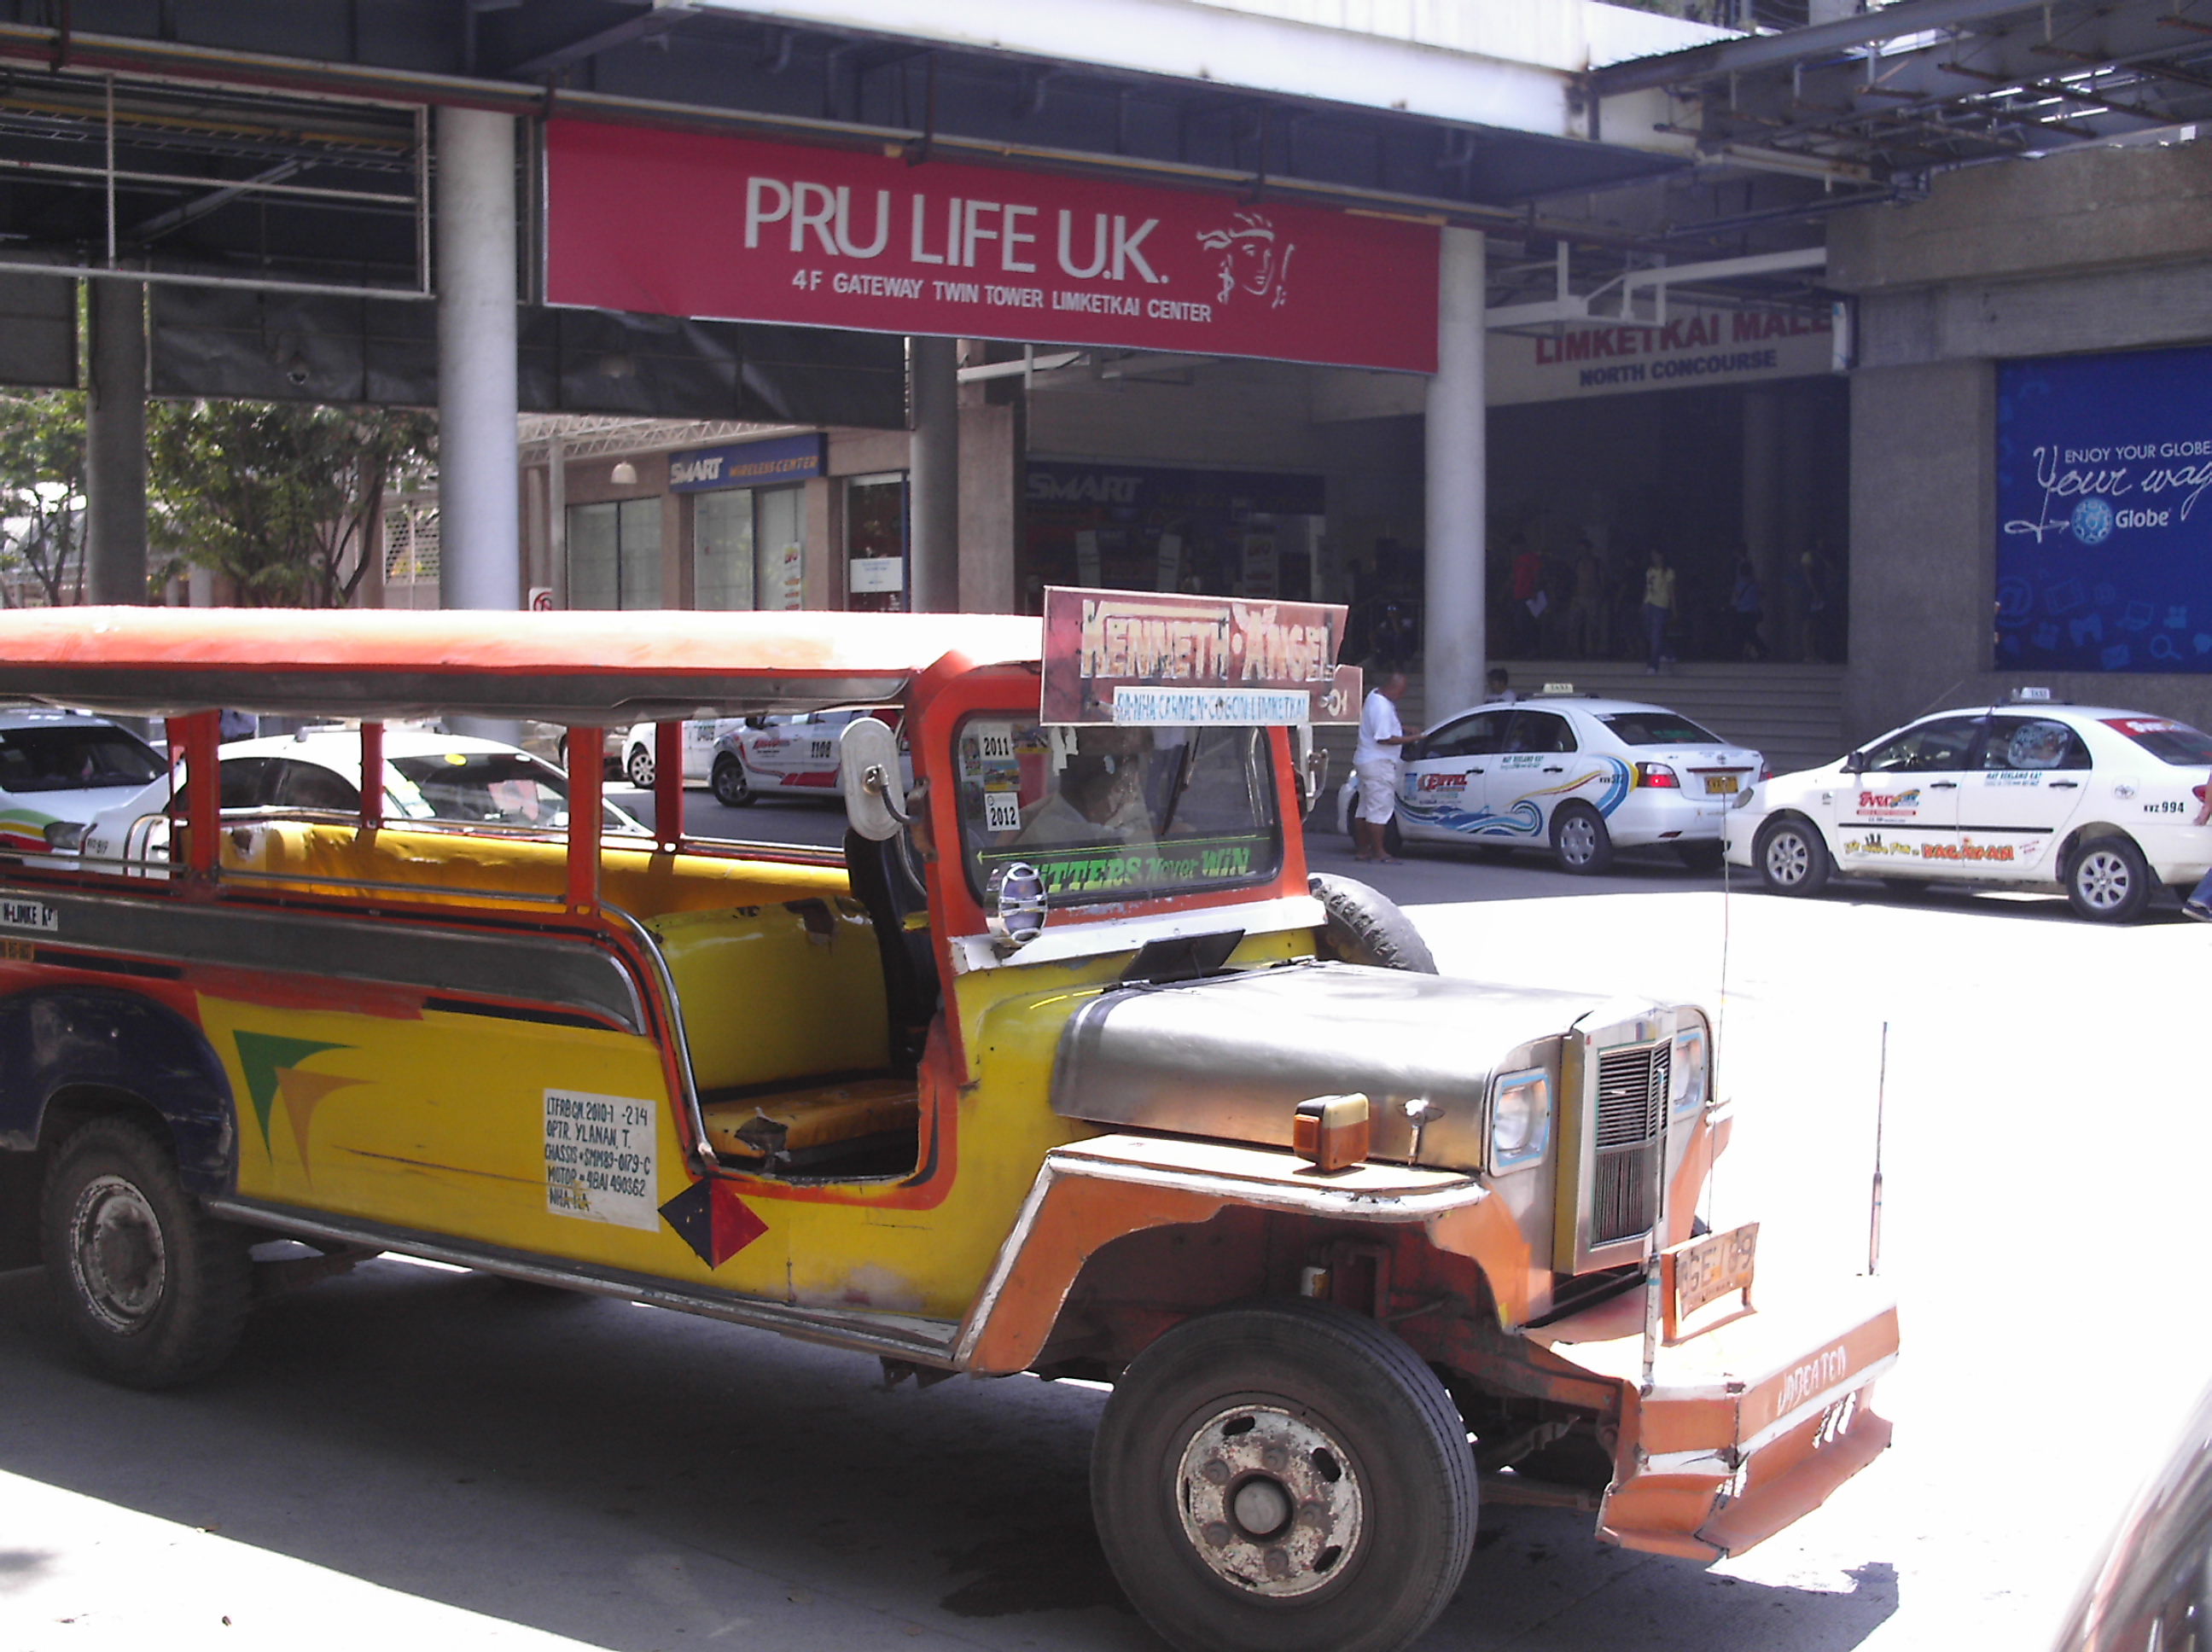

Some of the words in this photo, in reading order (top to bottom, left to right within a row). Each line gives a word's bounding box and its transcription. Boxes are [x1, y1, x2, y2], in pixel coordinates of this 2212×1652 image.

[745, 177, 890, 259] PRU
[911, 193, 1038, 272] LIFE
[1057, 209, 1169, 284] U.K.
[833, 272, 923, 299] GATEWAY
[932, 281, 980, 304] TWIN
[984, 285, 1044, 308] TOWER
[1051, 291, 1140, 316] LIMKETKAI
[1148, 299, 1213, 322] CENTER
[1535, 314, 1720, 365] LIMKETKAI
[1579, 361, 1646, 387] NORTH
[1650, 349, 1777, 381] CONCOURSE
[2064, 448, 2111, 463] ENJOY
[2115, 445, 2156, 460] YOUR
[670, 457, 724, 486] SMART
[1026, 473, 1144, 503] SMART
[2115, 509, 2168, 528] Globe
[1080, 599, 1231, 681] KENNETH
[983, 736, 1010, 756] 2011
[991, 807, 1016, 826] 2012
[2161, 800, 2185, 813] 994
